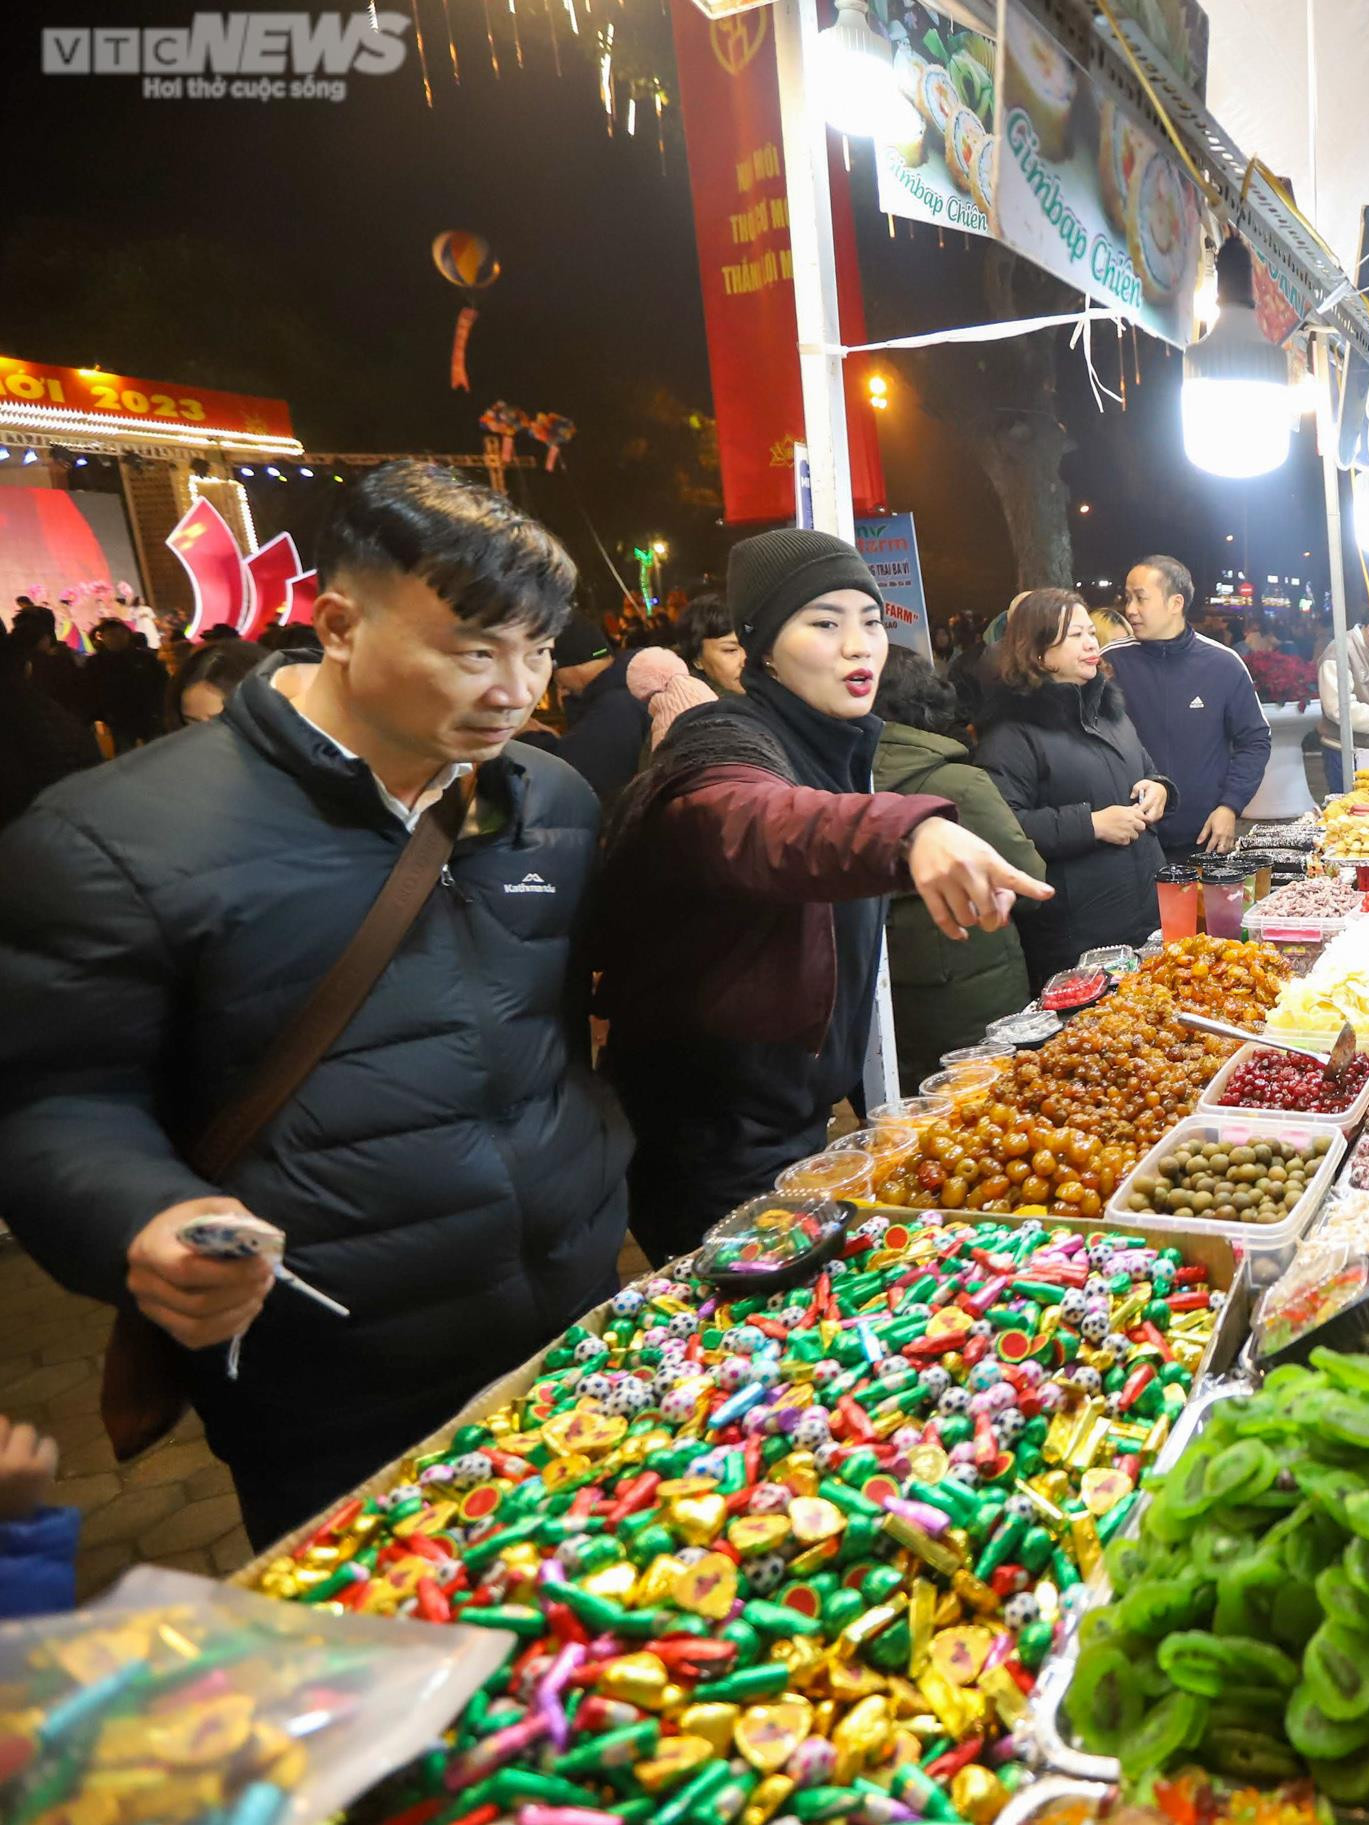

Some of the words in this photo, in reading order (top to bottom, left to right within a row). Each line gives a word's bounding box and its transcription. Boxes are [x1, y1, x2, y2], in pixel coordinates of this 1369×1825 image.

[948, 196, 988, 231] Chiên
[1007, 112, 1088, 264] Gimbap
[1091, 234, 1142, 308] Chiên
[90, 386, 206, 421] 2023
